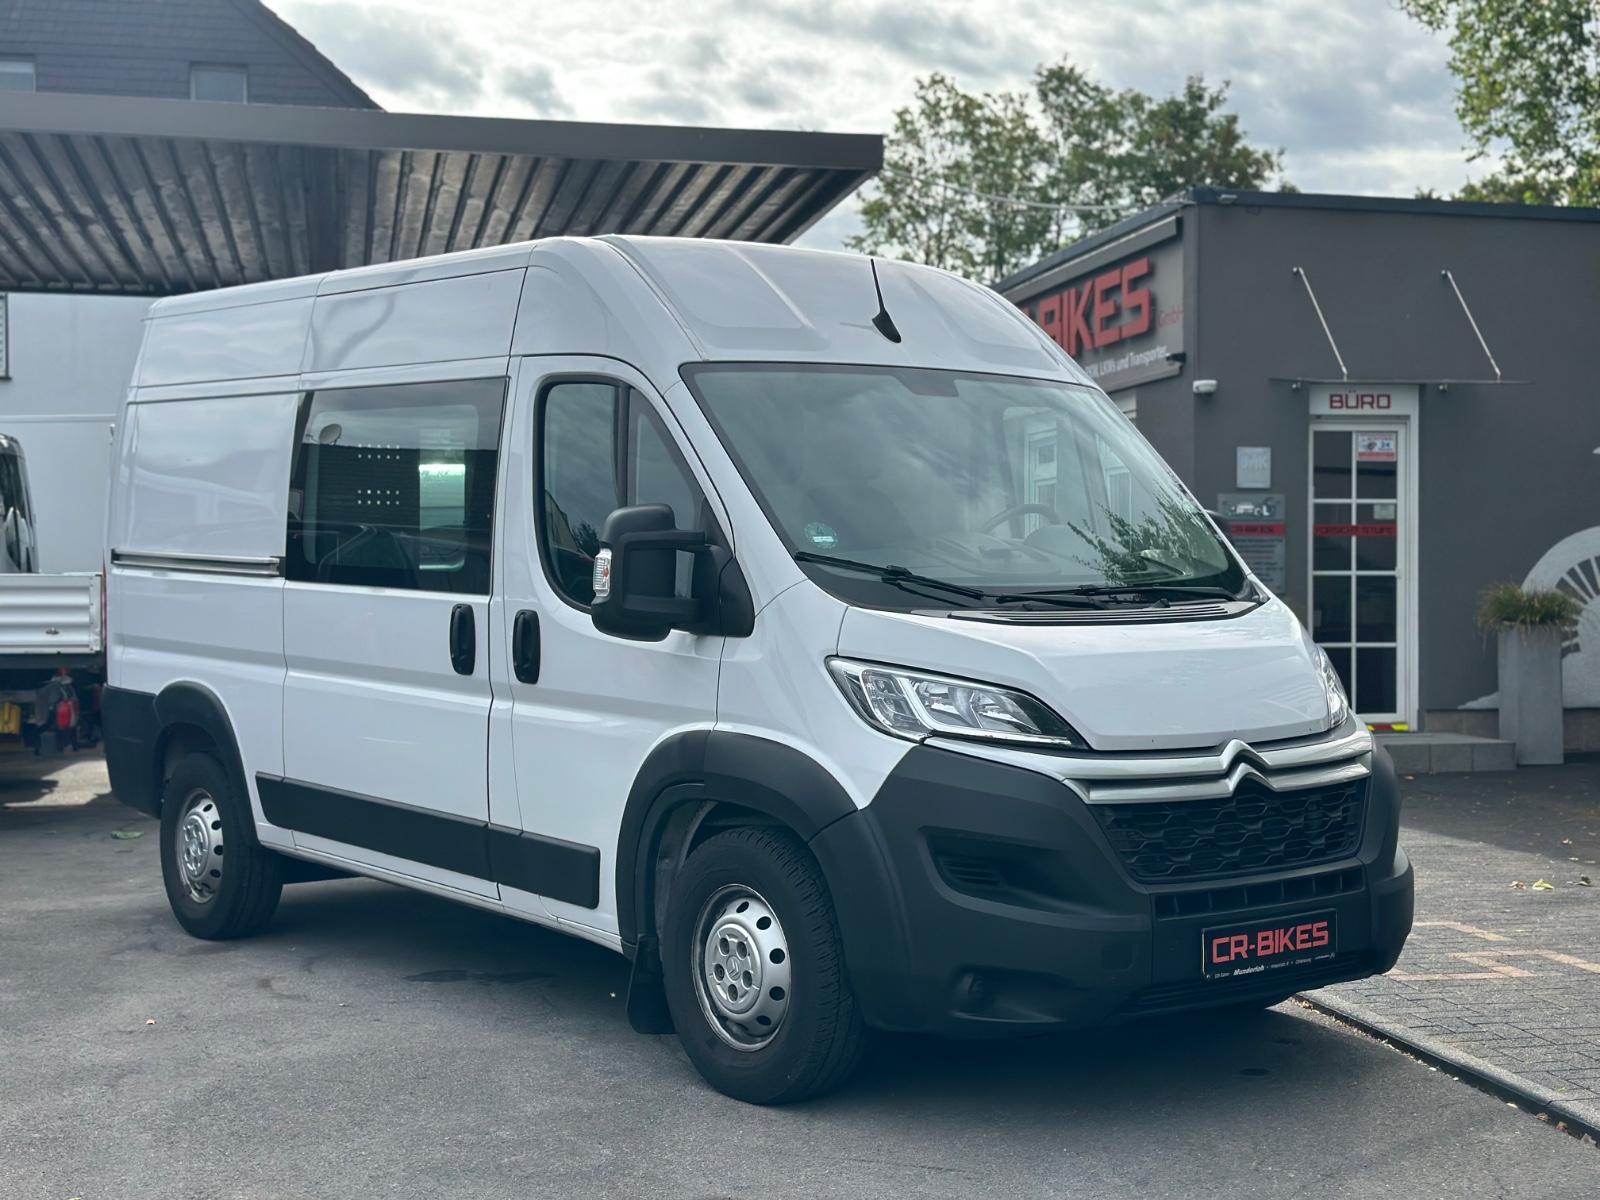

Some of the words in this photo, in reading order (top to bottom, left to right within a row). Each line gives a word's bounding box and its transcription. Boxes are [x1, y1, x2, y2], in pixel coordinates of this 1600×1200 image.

[1022, 256, 1151, 358] BIKES
[1329, 388, 1391, 410] BÜRO
[1212, 921, 1329, 964] CR-BIKES
